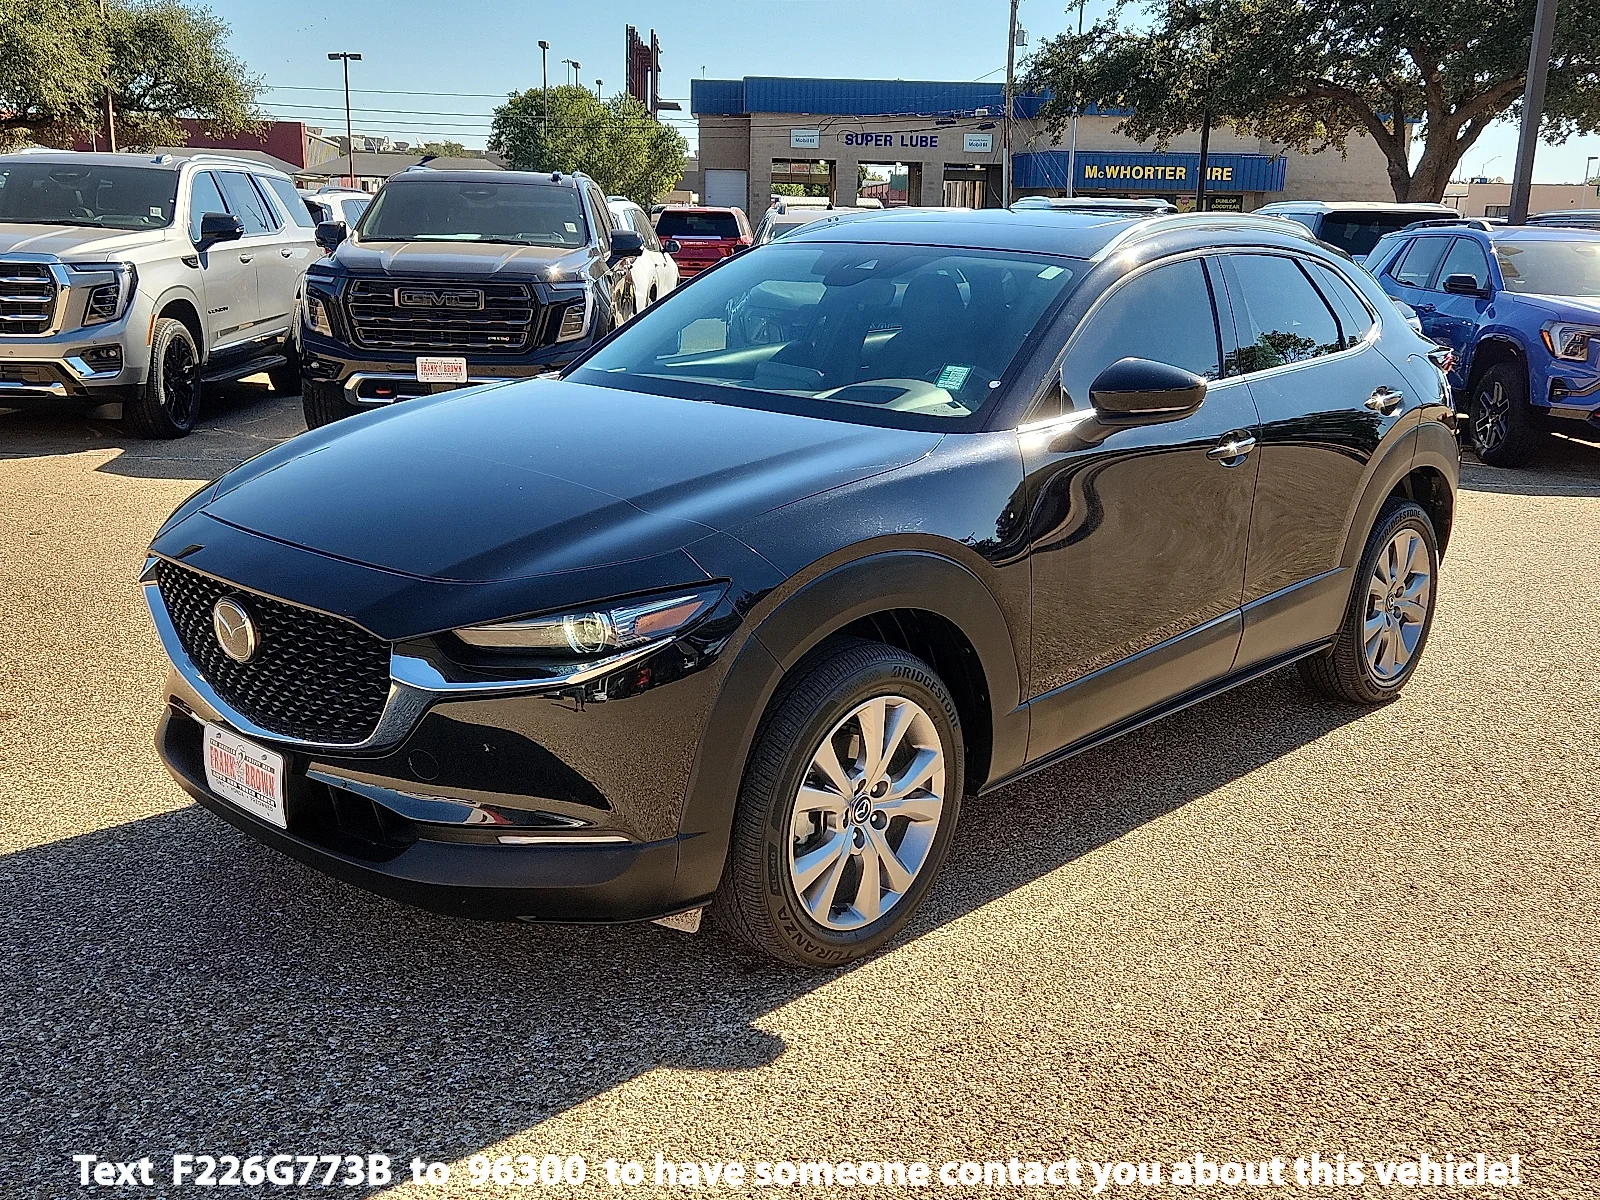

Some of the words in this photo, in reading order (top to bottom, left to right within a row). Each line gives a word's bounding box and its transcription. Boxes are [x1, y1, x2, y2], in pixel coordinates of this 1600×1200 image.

[845, 133, 893, 147] SUPER
[900, 135, 939, 148] LUBE
[1084, 165, 1186, 180] McWHORTER
[1197, 167, 1233, 181] IRE
[400, 290, 478, 308] GMC
[891, 665, 960, 733] BRIDGESTONE
[210, 745, 236, 779] FRANK
[244, 763, 275, 797] BROWN
[777, 906, 854, 961] TURANZA
